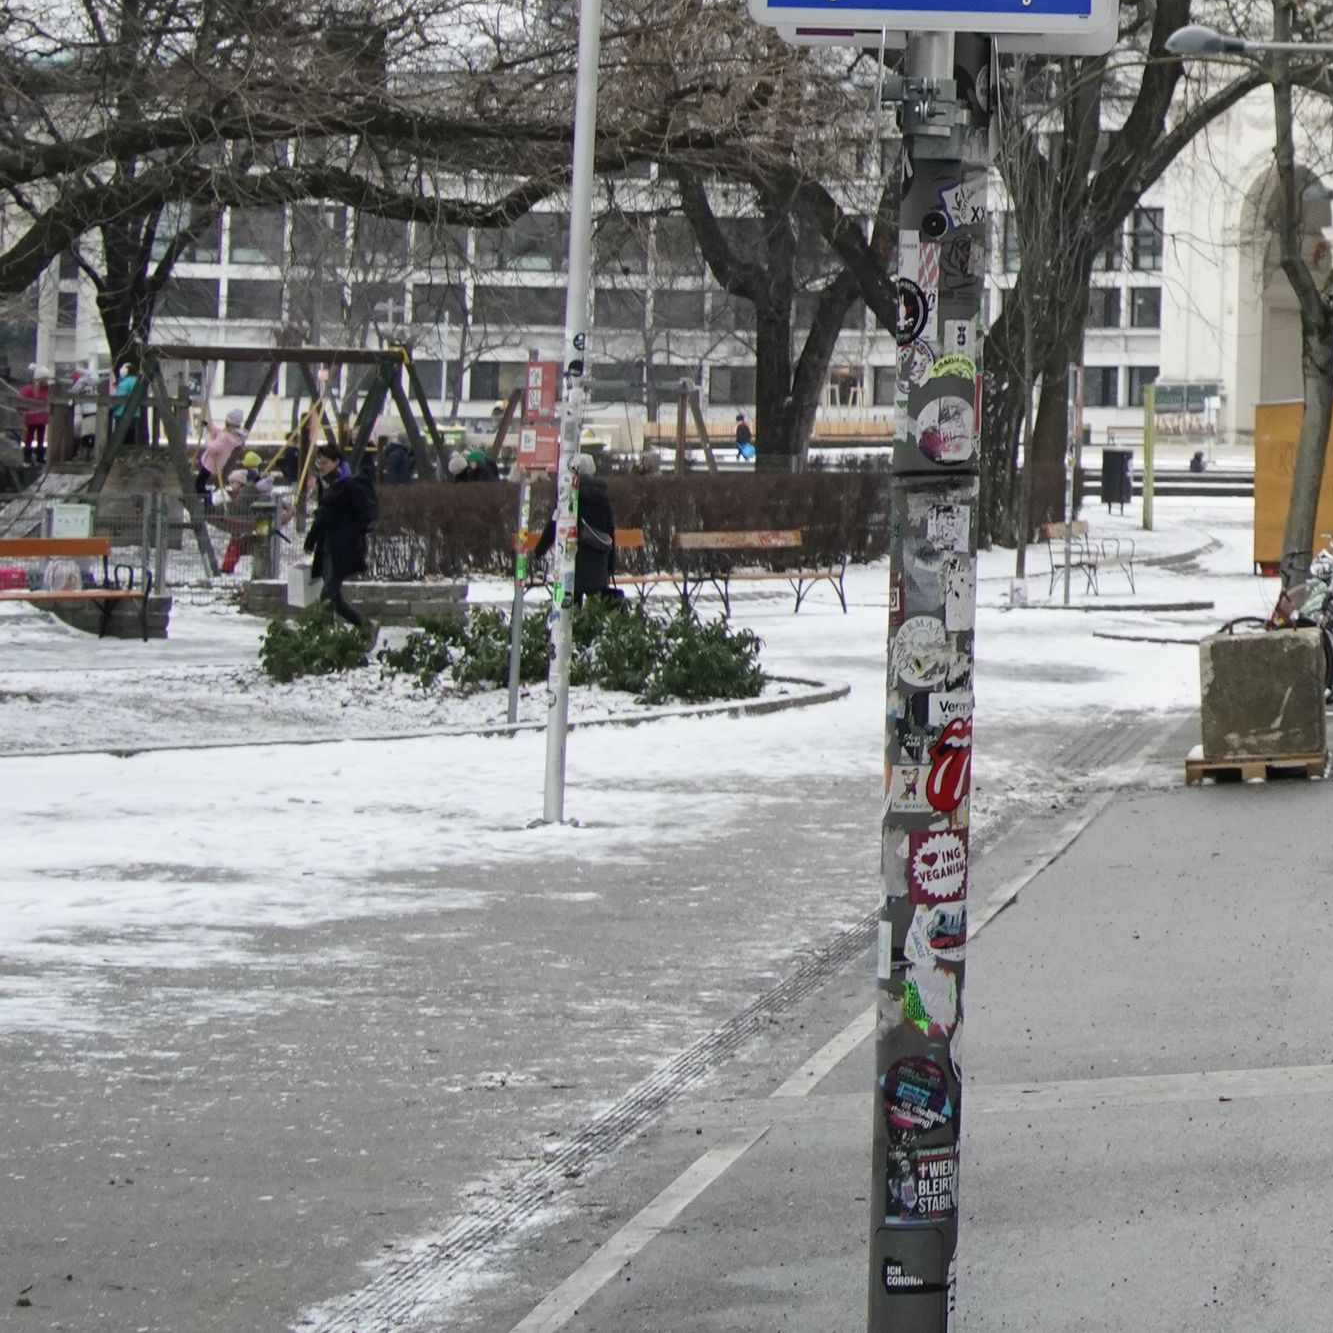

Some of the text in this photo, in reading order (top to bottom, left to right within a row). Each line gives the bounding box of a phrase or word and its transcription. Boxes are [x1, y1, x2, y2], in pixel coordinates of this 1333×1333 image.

[918, 861, 965, 883] VEGANISM
[929, 1159, 954, 1177] WIEN
[918, 1194, 953, 1213] STABIL
[887, 1265, 902, 1276] ICH
